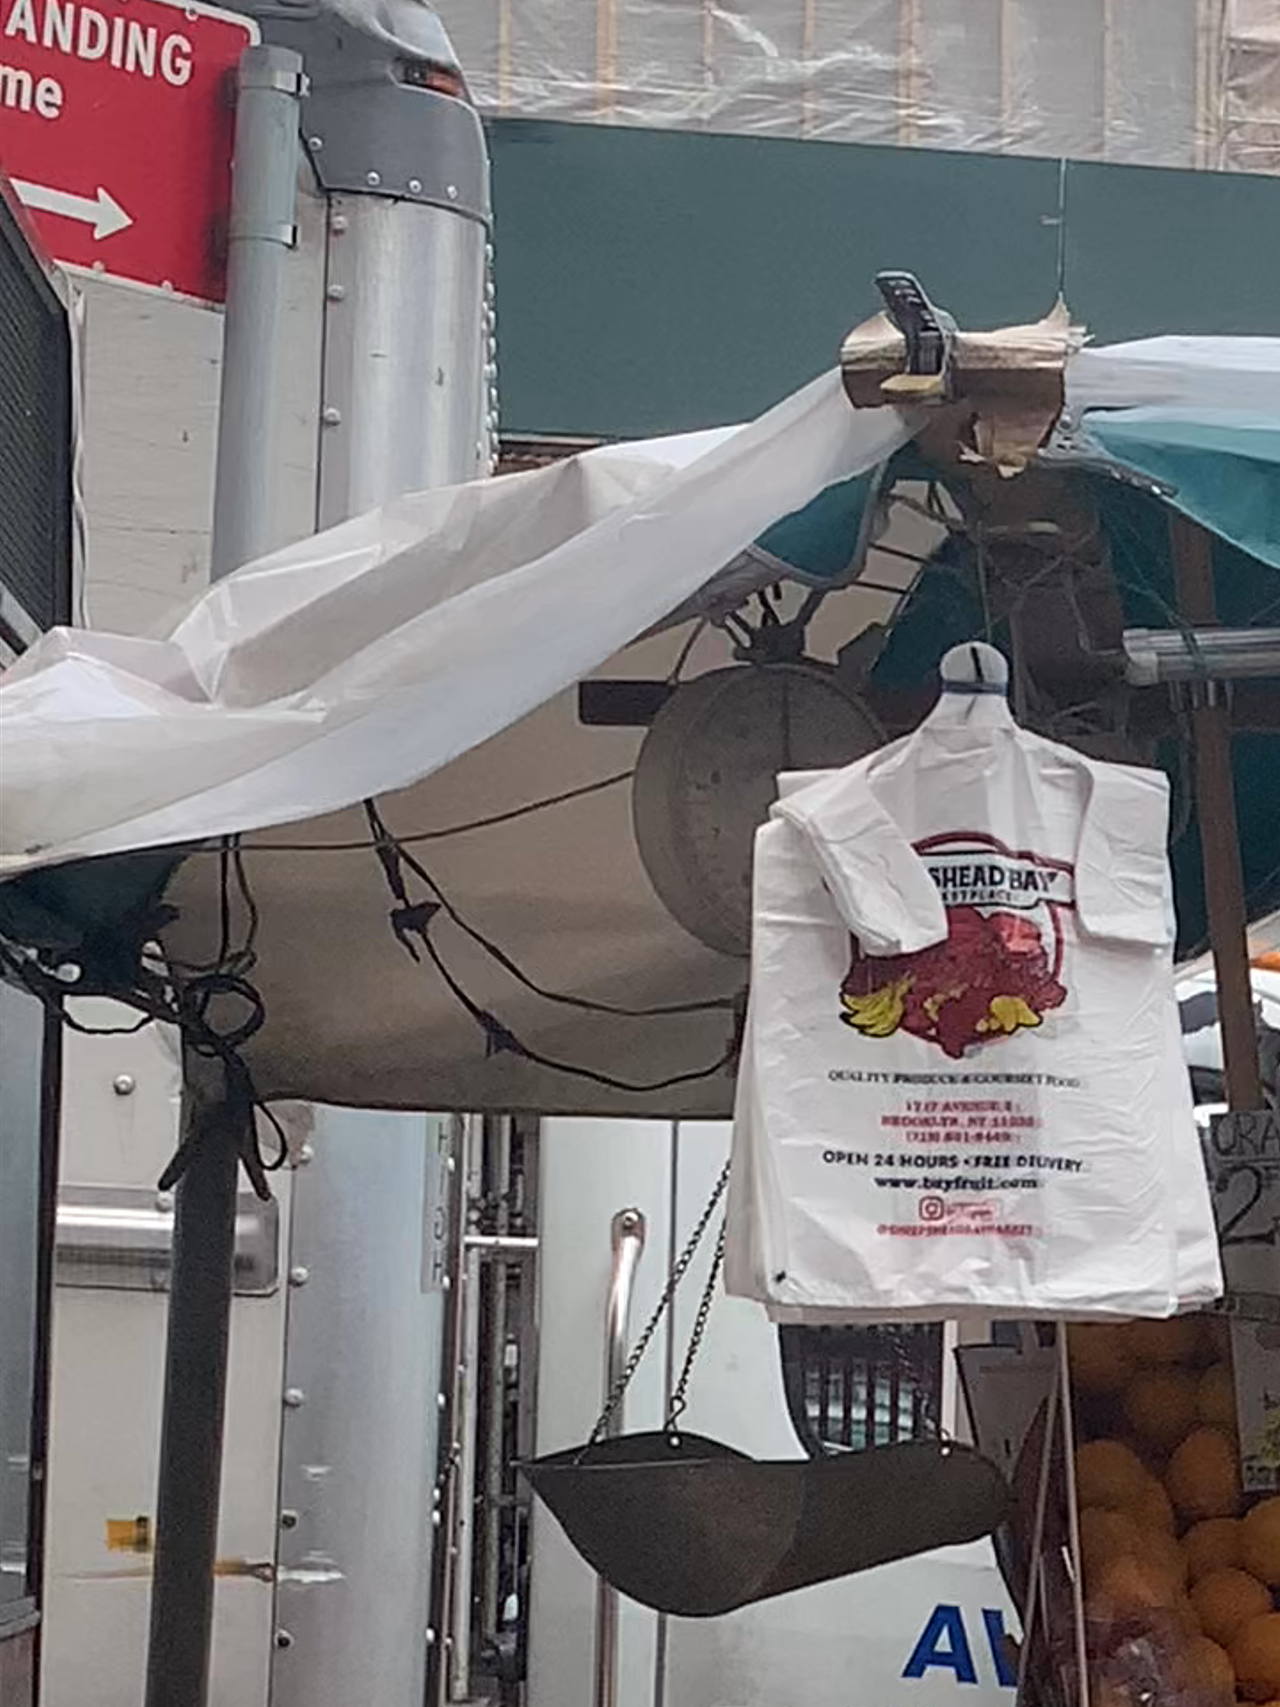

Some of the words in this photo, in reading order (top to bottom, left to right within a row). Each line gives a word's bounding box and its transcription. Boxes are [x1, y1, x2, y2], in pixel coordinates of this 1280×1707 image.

[1009, 869, 1058, 892] BAY
[822, 1150, 869, 1166] OPEN
[873, 1153, 894, 1166] 24
[900, 1153, 958, 1168] HOURS
